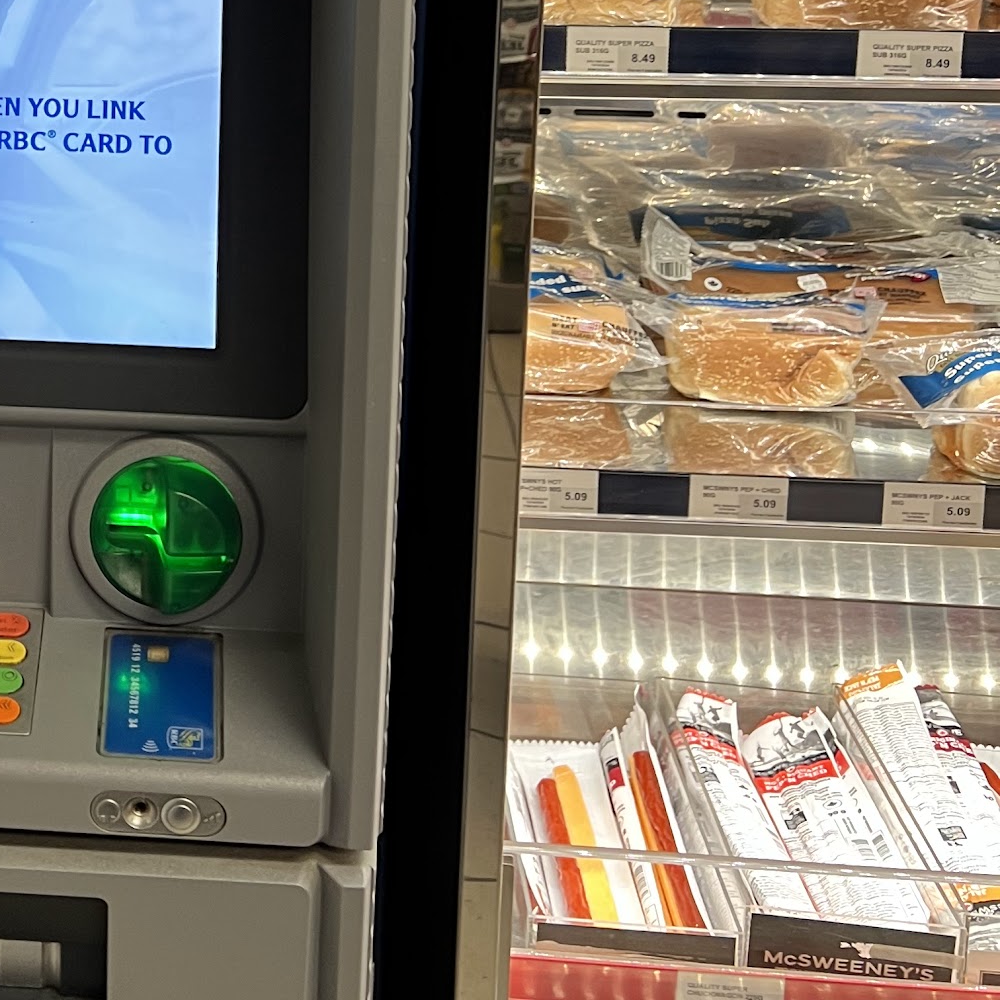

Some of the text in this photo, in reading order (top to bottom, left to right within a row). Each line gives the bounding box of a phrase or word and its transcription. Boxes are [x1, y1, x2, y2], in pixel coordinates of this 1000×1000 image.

[631, 53, 656, 63] 8.49
[925, 58, 950, 68] 8.49
[28, 98, 79, 118] YOU
[87, 100, 146, 120] LINK
[63, 132, 132, 153] CARD
[139, 135, 172, 155] TO
[565, 492, 588, 501] 5.09
[753, 499, 776, 508] 5.09
[946, 506, 971, 516] 5.09
